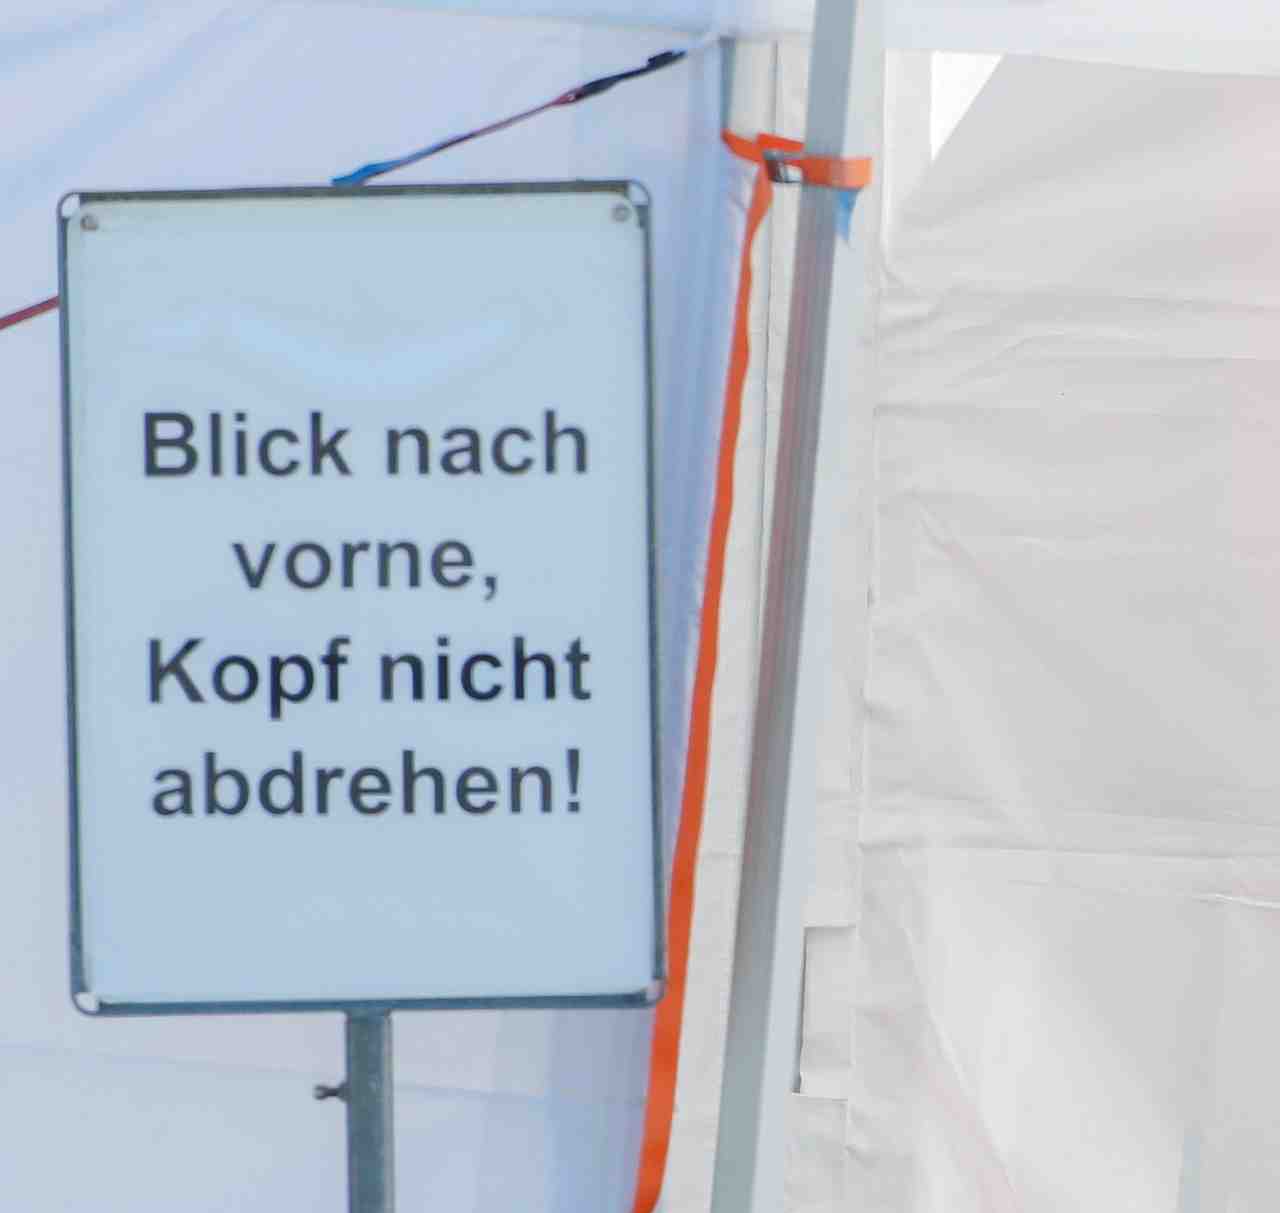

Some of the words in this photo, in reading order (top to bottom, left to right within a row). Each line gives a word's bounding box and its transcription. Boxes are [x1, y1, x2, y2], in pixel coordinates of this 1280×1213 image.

[143, 411, 352, 478] Blick
[386, 410, 588, 476] nach
[231, 540, 498, 600] vorne,
[148, 636, 350, 720] Kopf
[380, 636, 592, 703] nicht
[151, 748, 582, 817] abdrehen!
